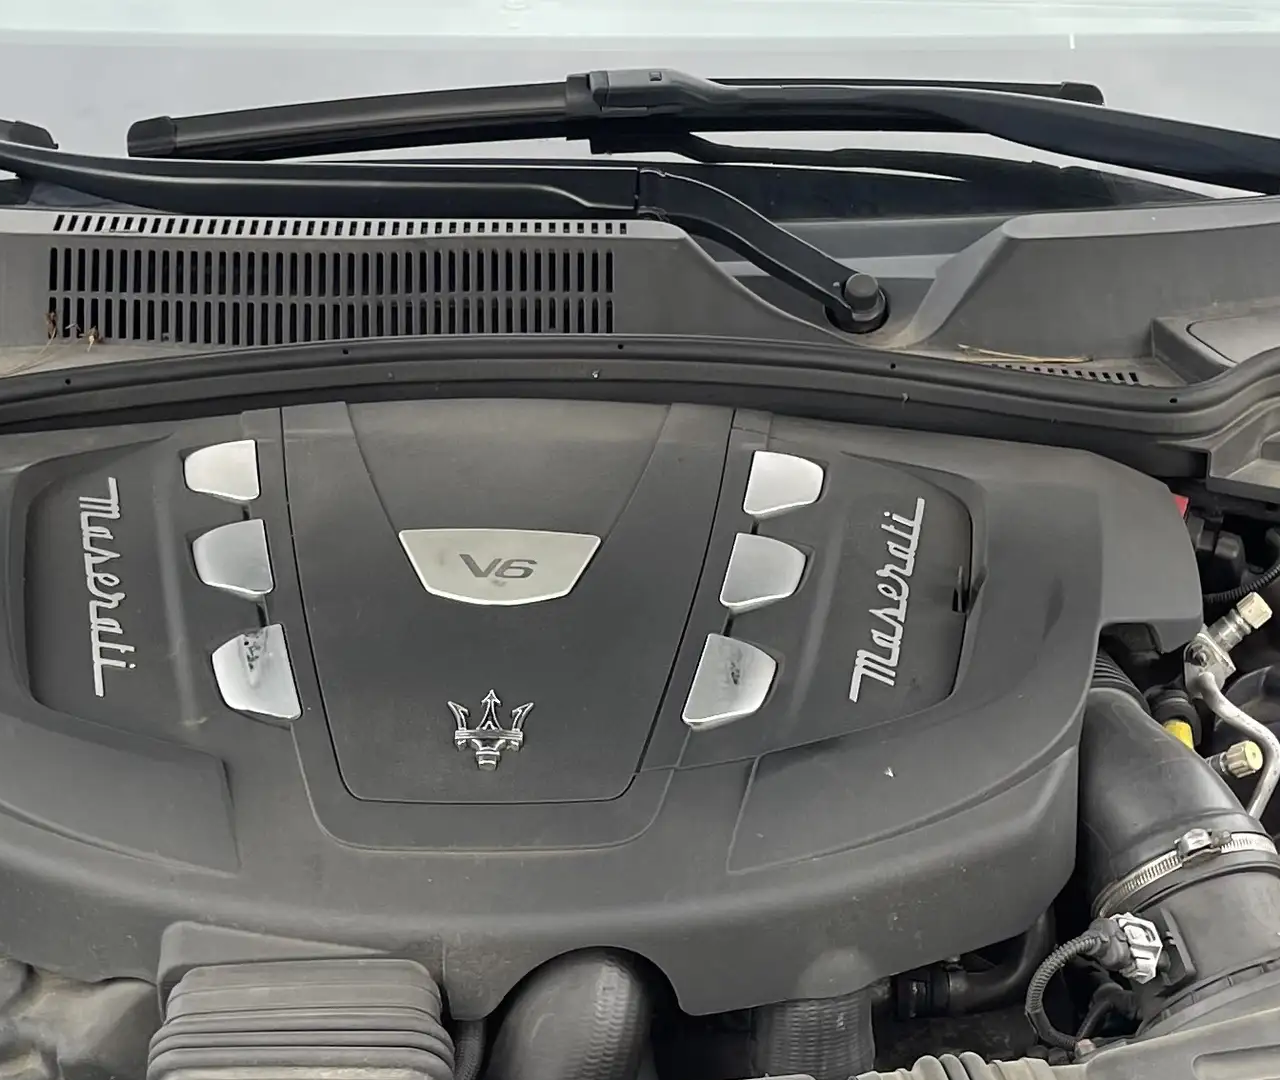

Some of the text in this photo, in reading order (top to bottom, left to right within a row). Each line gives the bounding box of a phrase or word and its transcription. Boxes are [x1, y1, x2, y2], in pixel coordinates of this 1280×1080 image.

[79, 477, 136, 697] Maserati
[459, 553, 538, 579] V6
[849, 497, 925, 702] Maserati
